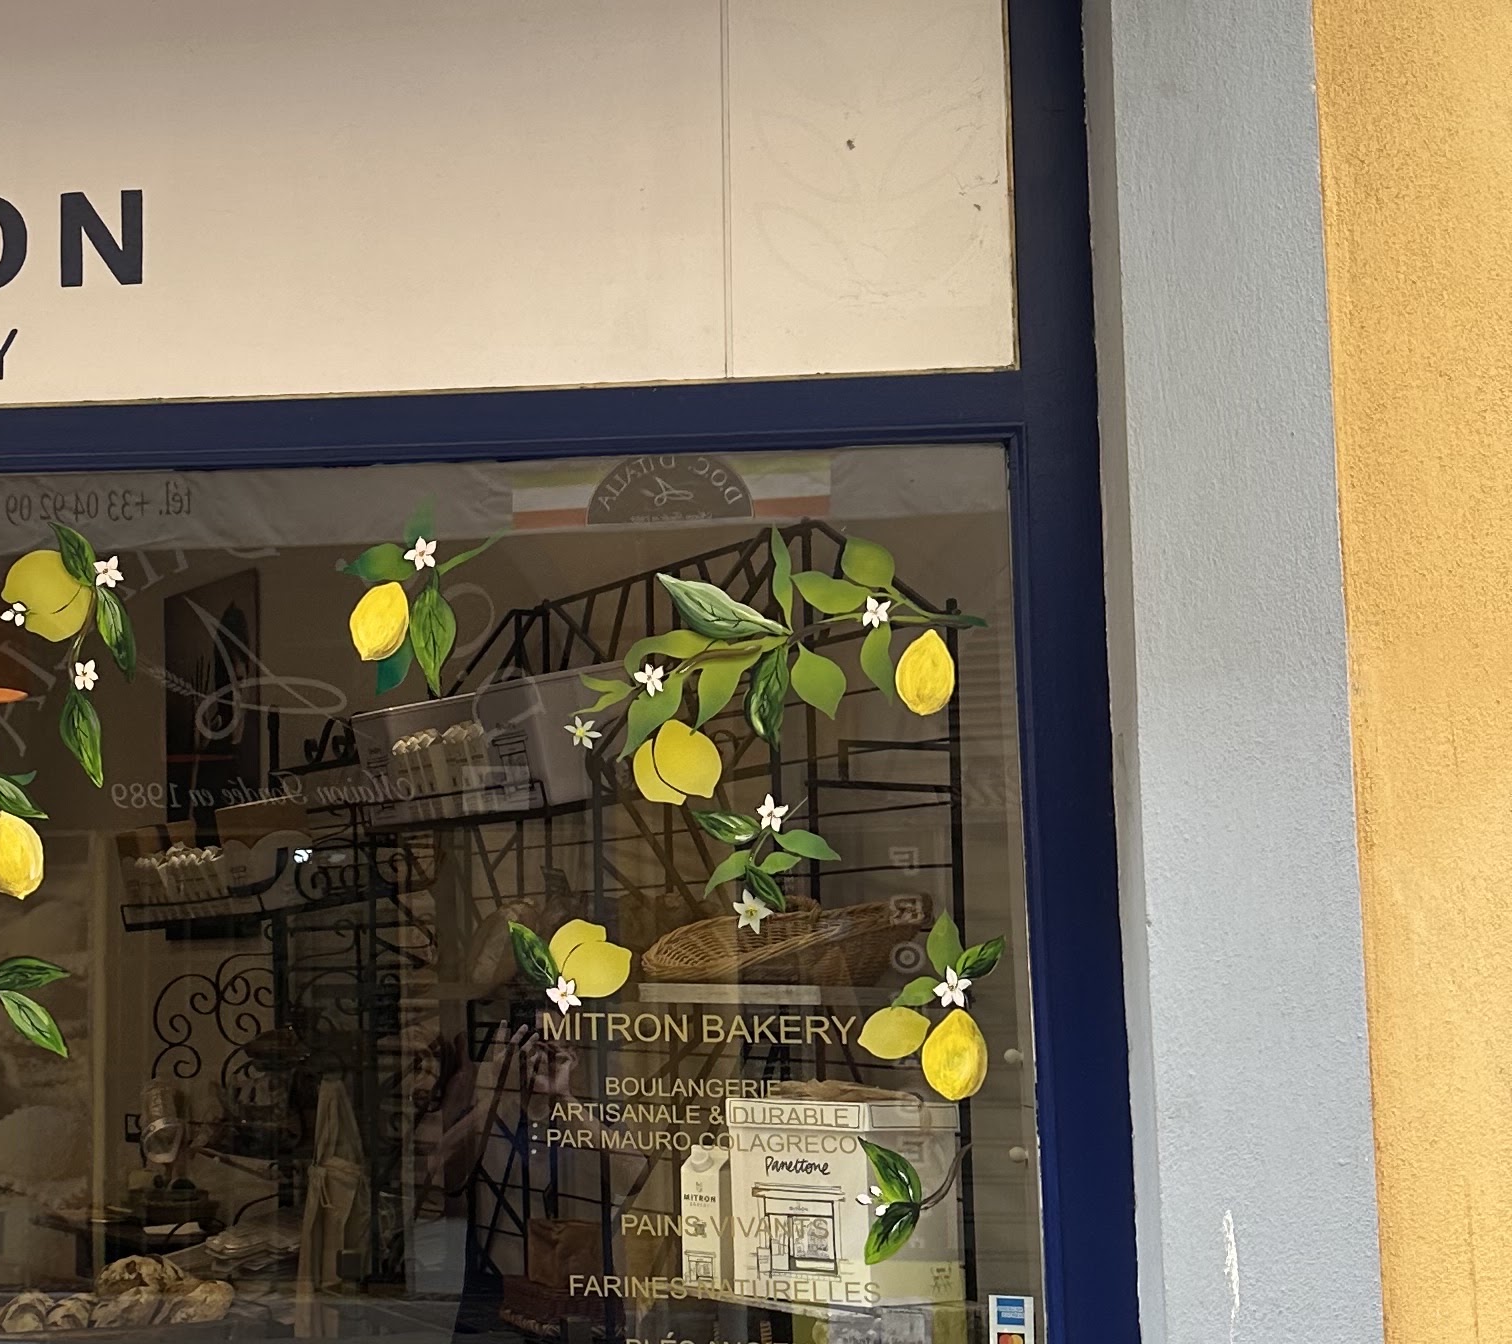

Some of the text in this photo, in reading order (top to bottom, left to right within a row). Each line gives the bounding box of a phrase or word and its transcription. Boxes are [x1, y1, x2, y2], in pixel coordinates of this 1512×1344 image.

[543, 1011, 857, 1045] MITRON BAKERY
[605, 1076, 782, 1098] BOULANGERIE
[550, 1102, 849, 1127] ARTISANALE & DURABLE
[546, 1129, 858, 1154] PAR MAURO COLAGRECO
[684, 1193, 716, 1203] MITRON
[621, 1214, 830, 1239] PAINS VIVANTS
[569, 1274, 882, 1303] FARINES NATURELLES
